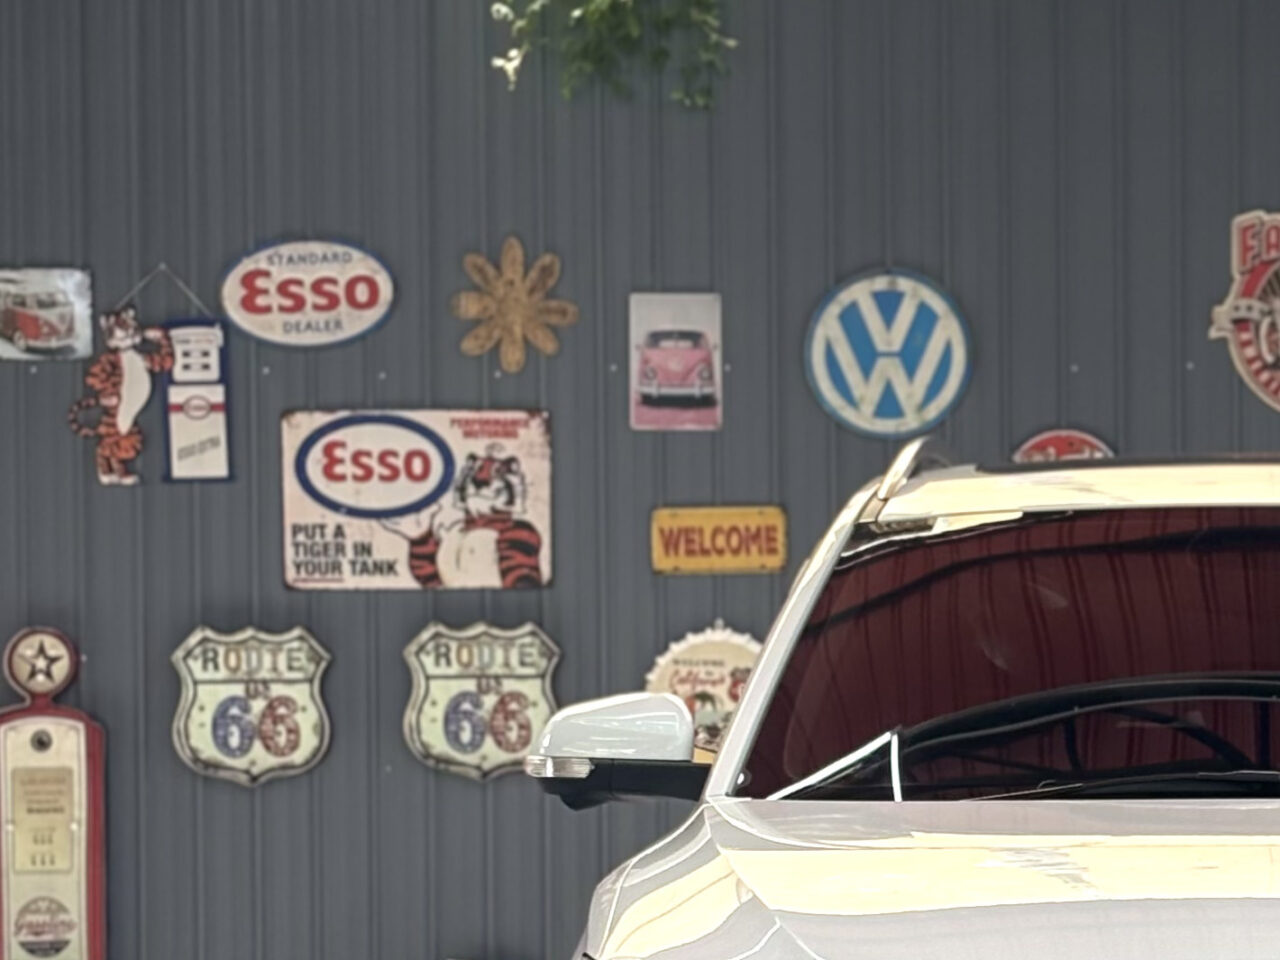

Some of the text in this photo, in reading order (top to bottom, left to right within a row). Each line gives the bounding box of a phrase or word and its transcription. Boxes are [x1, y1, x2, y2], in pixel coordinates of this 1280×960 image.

[267, 251, 353, 266] STANDARD
[283, 319, 344, 334] DEALER
[292, 523, 346, 540] PUT A
[658, 524, 779, 557] WELCOME
[292, 541, 373, 558] TIGER IN
[292, 559, 398, 577] YOUR TANK
[201, 644, 306, 674] ROUTE
[433, 641, 537, 671] ROUTE
[211, 694, 301, 760] 66
[443, 690, 533, 755] 66
